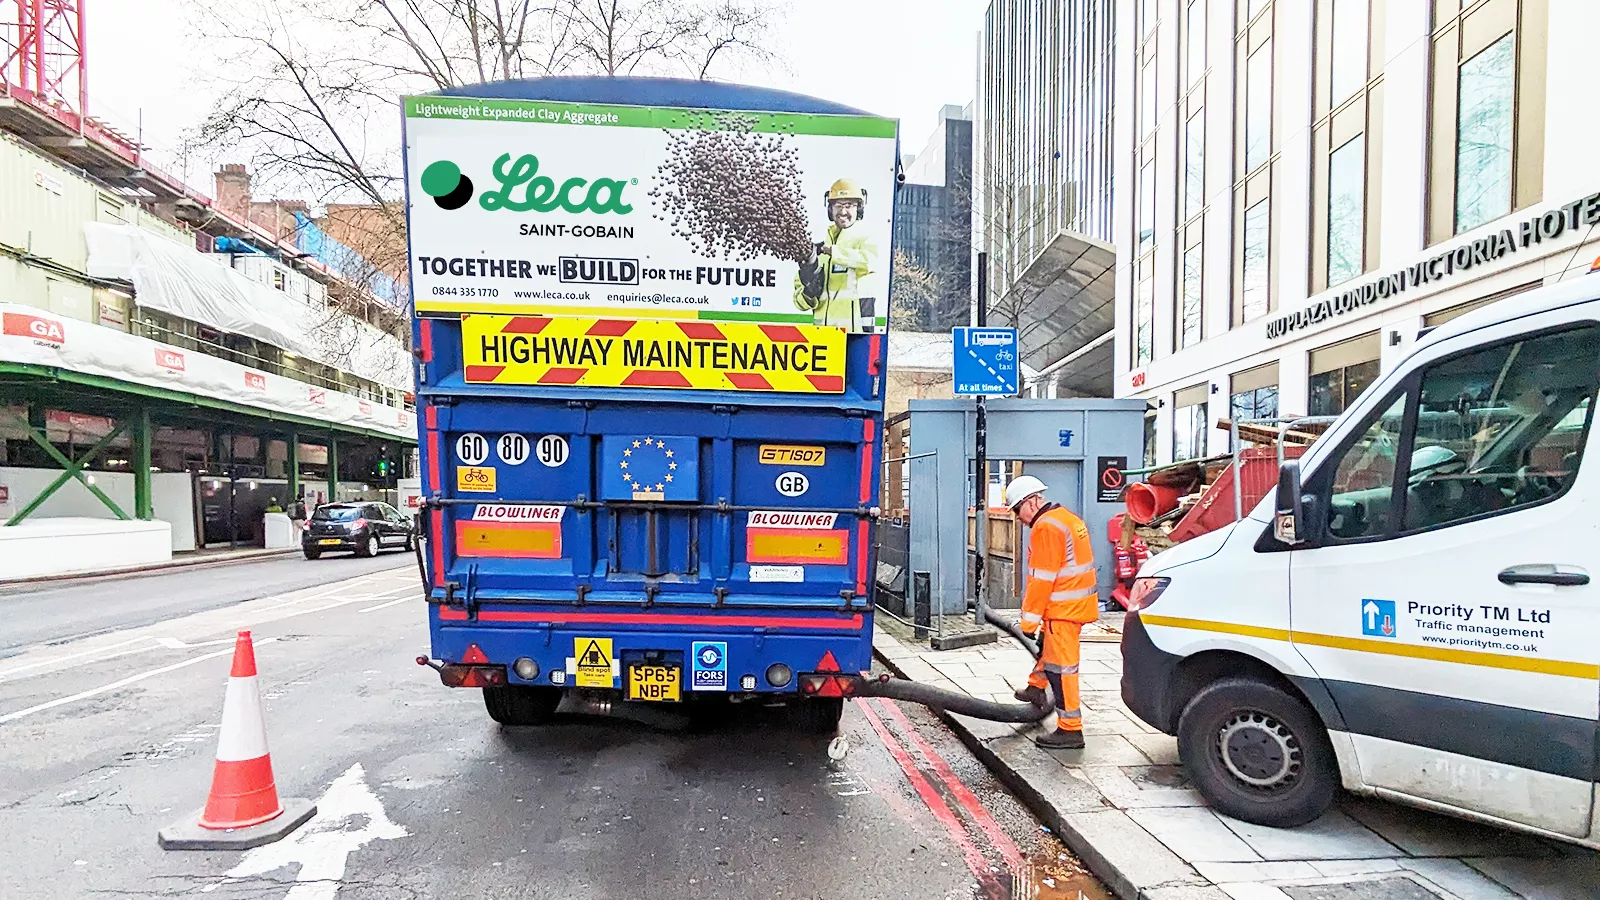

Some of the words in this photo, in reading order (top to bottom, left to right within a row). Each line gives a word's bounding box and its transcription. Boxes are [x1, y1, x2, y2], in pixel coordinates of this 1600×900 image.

[415, 103, 480, 118] Lightweight
[483, 106, 535, 120] Expanded
[538, 108, 559, 122] Clay
[563, 110, 618, 124] Aggregate
[519, 224, 634, 238] SAINT-GOBAIN
[418, 256, 532, 279] TOGETHER
[536, 264, 557, 276] WE
[562, 259, 636, 282] BUILD
[642, 268, 666, 280] FOR
[670, 269, 692, 281] THE
[696, 266, 776, 287] FUTURE
[1266, 317, 1287, 340] RIU
[1287, 300, 1333, 331] PLAZA
[1333, 270, 1406, 315] LONDON
[1406, 230, 1517, 287] VICTORIA
[432, 286, 457, 296] 0844
[460, 287, 475, 297] 335
[478, 288, 499, 298] 1770
[514, 290, 591, 301] www.leca.co.uk
[607, 293, 709, 305] enquiries@leca.co.uk
[30, 320, 63, 339] GA
[165, 353, 184, 368] GA
[481, 335, 613, 367] HIGHWAY
[623, 340, 827, 372] MAINTENANCE
[999, 362, 1013, 370] taxi
[251, 376, 265, 389] GA
[958, 383, 968, 392] At
[970, 383, 980, 392] all
[982, 383, 1003, 392] times
[462, 435, 483, 460] 60
[502, 435, 524, 460] 80
[542, 438, 563, 463] 90
[780, 476, 804, 492] GB
[477, 505, 561, 519] BLOWLINER
[752, 513, 833, 526] BLOWLINER
[1408, 601, 1474, 621] Priority
[1480, 605, 1510, 621] TM
[1518, 608, 1551, 624] Ltd
[1415, 618, 1453, 631] Traffic
[1456, 624, 1545, 639] management
[1422, 635, 1538, 653] www.prioritytm.co.uk
[596, 666, 610, 674] spot
[634, 668, 676, 683] SP65
[696, 671, 724, 680] FORS
[640, 684, 670, 698] NBF
